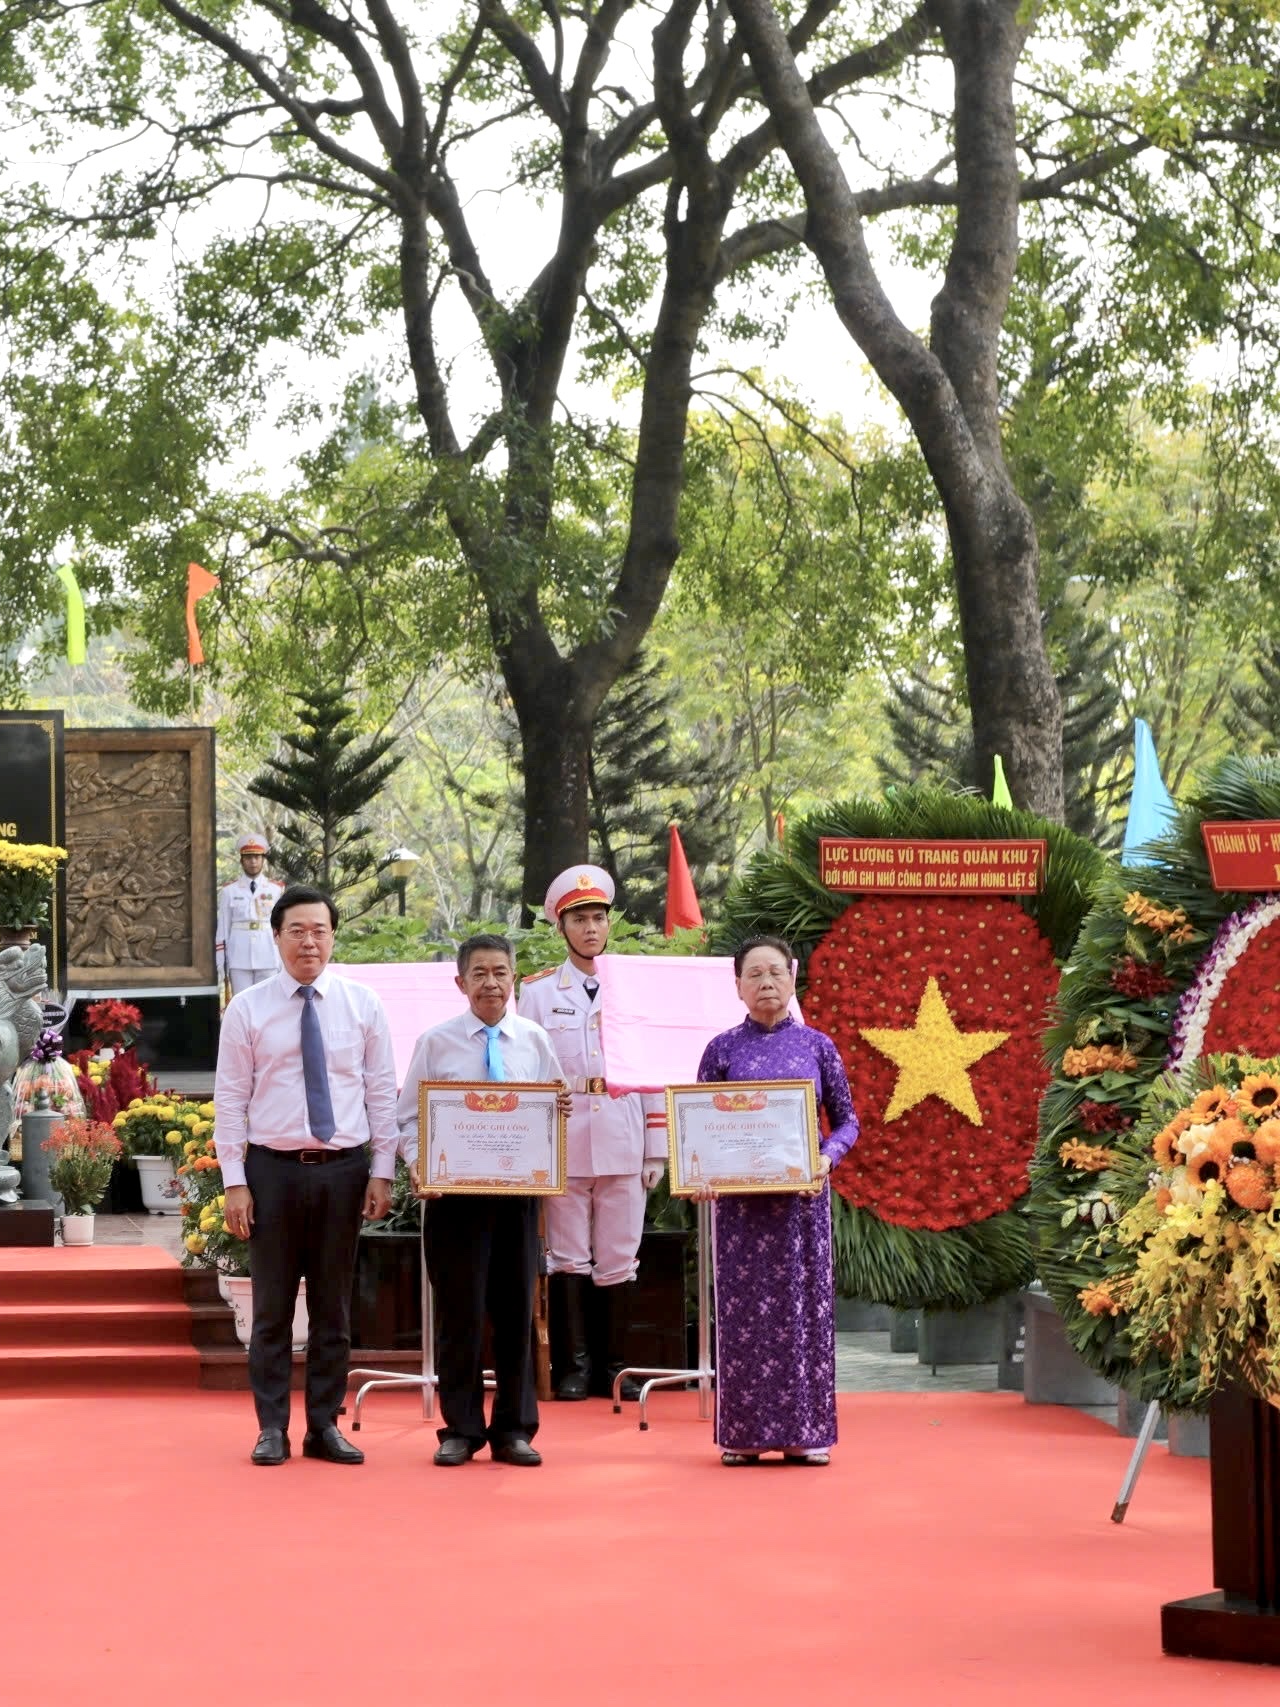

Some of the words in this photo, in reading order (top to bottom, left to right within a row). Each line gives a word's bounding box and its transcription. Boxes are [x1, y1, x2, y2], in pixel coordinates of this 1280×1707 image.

[1211, 831, 1247, 853] THÀNH
[1247, 828, 1262, 853] ỦY
[825, 846, 849, 865] LỰC
[852, 847, 894, 866] LƯỢNG
[898, 846, 914, 864] VŨ
[918, 849, 959, 864] TRANG
[963, 846, 998, 866] QUÂN
[1002, 849, 1028, 864] KHU
[1032, 849, 1040, 864] 7
[860, 871, 875, 886] GHI
[876, 868, 896, 887] NHỚ
[898, 869, 922, 887] CÔNG
[924, 871, 937, 887] ƠN
[940, 870, 958, 887] CÁC
[960, 872, 978, 887] ANH
[981, 869, 1006, 888] HÙNG
[1007, 869, 1027, 891] LIỆT
